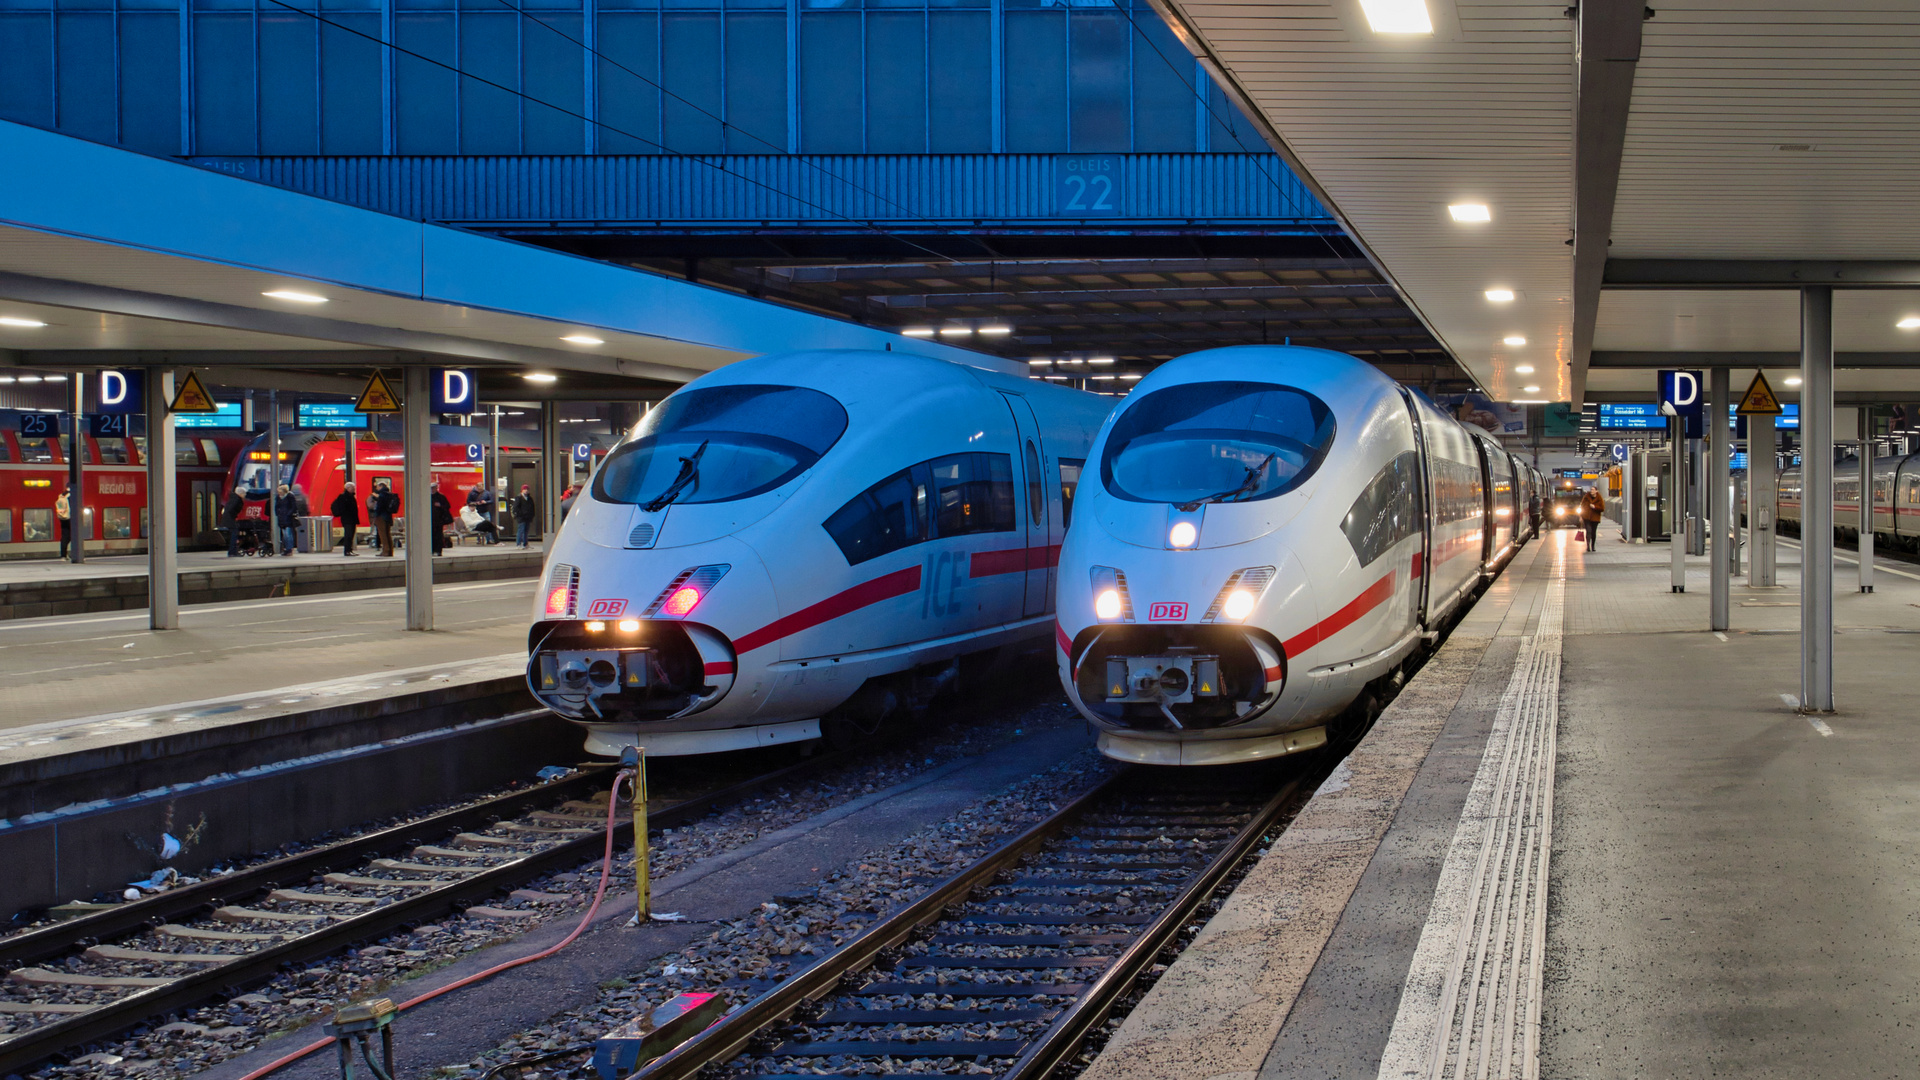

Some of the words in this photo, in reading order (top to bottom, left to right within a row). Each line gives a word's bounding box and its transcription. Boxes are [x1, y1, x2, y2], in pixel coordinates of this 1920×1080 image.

[1066, 159, 1111, 172] GLEIS
[1064, 175, 1113, 210] 22
[102, 370, 127, 404] D
[444, 370, 469, 404] D
[1674, 372, 1698, 405] D
[24, 415, 48, 433] 25
[100, 415, 123, 432] 24
[468, 444, 478, 458] C
[577, 444, 588, 458] C
[1612, 443, 1623, 458] C
[98, 483, 124, 495] REGIO
[921, 550, 966, 620] ICE
[591, 600, 623, 616] DB
[1152, 603, 1185, 619] DB
